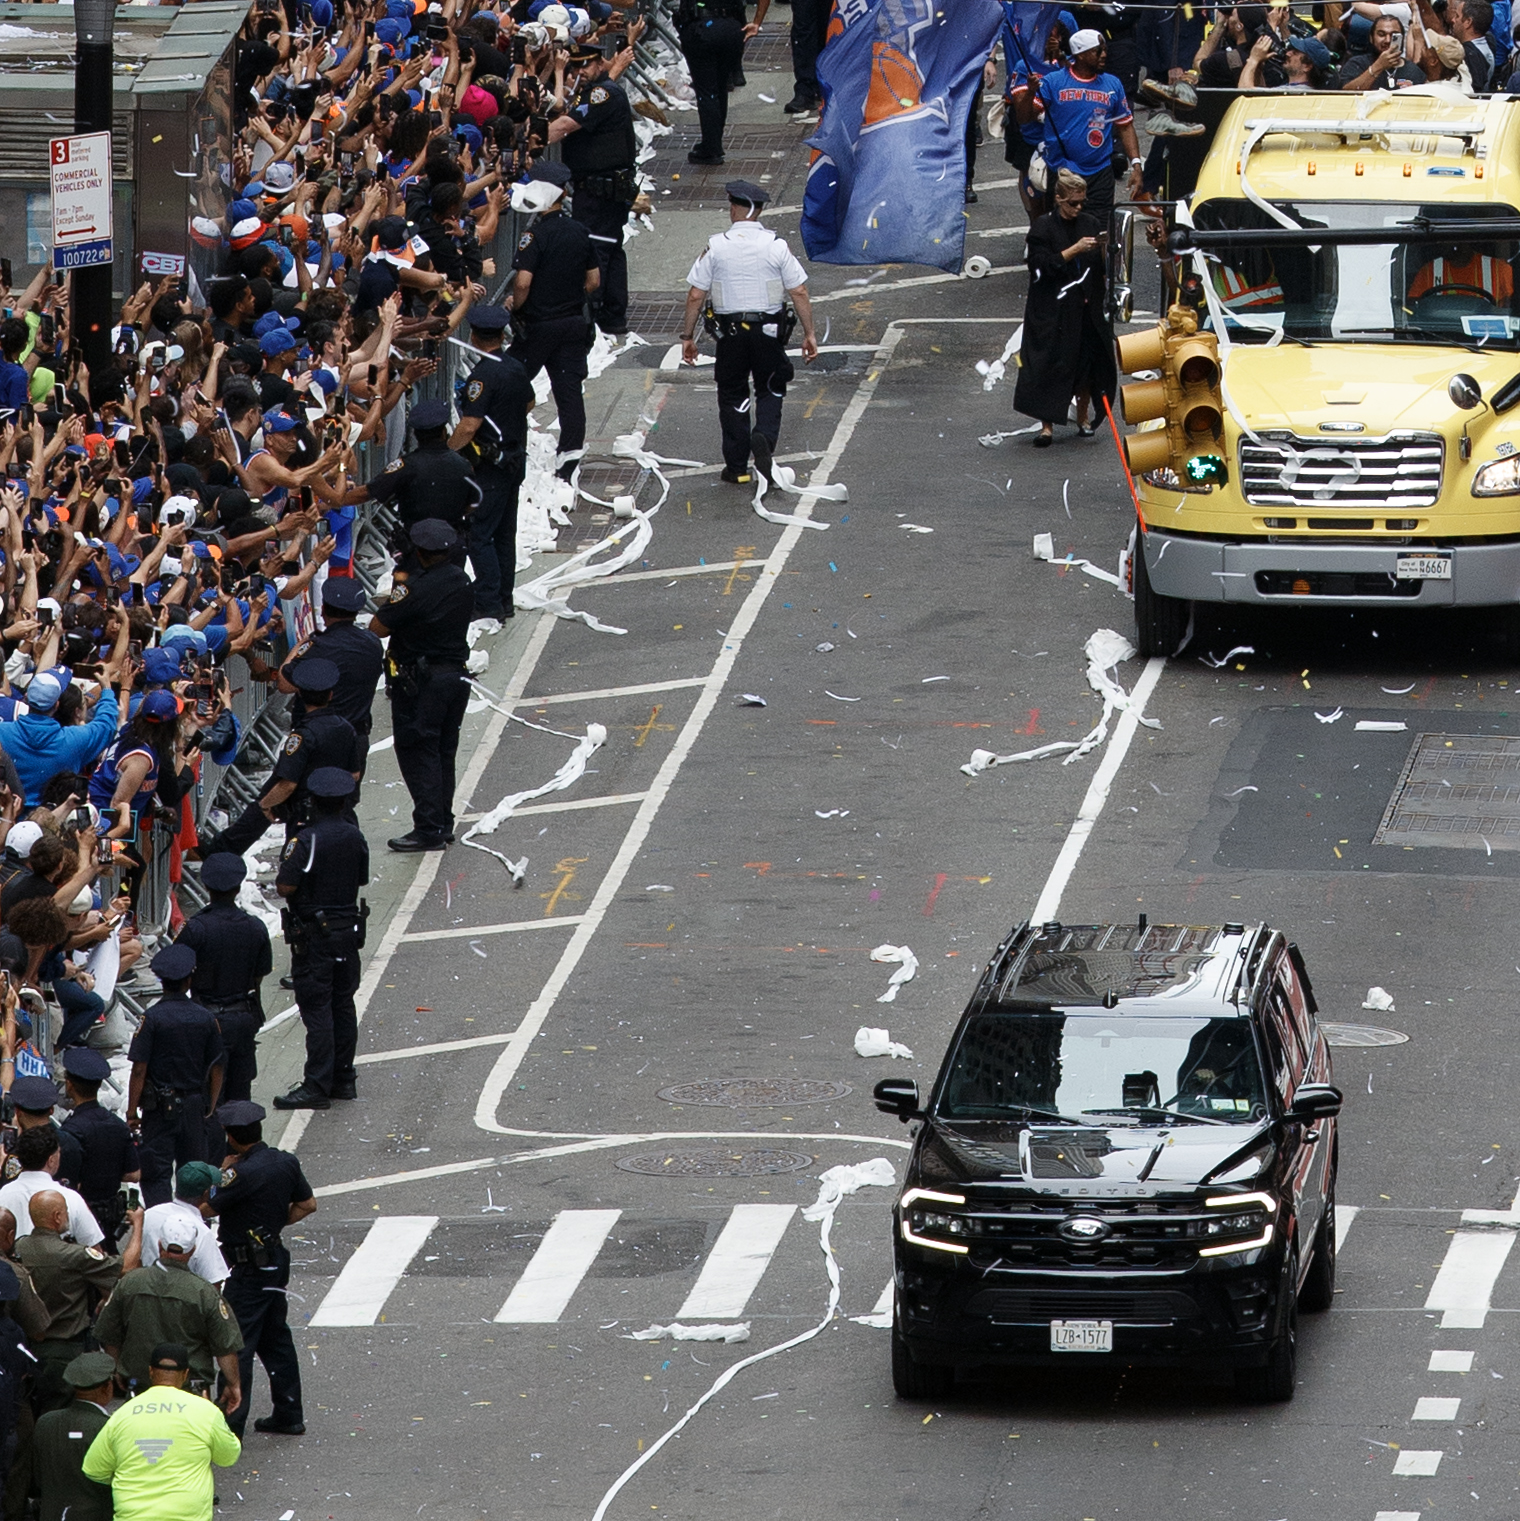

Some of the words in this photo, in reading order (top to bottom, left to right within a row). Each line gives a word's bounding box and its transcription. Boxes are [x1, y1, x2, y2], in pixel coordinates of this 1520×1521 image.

[1058, 89, 1081, 105] NEW
[1081, 89, 1111, 105] YORK
[55, 142, 66, 162] 3
[54, 168, 98, 182] COMMERCIAL
[54, 180, 84, 193] VEHICLES
[86, 178, 103, 189] ONLY
[55, 215, 75, 226] Except
[75, 212, 95, 224] Sunday
[62, 249, 98, 266] 100722
[141, 256, 184, 274] CB1
[1426, 560, 1448, 574] 6667
[132, 1402, 187, 1416] DSNY
